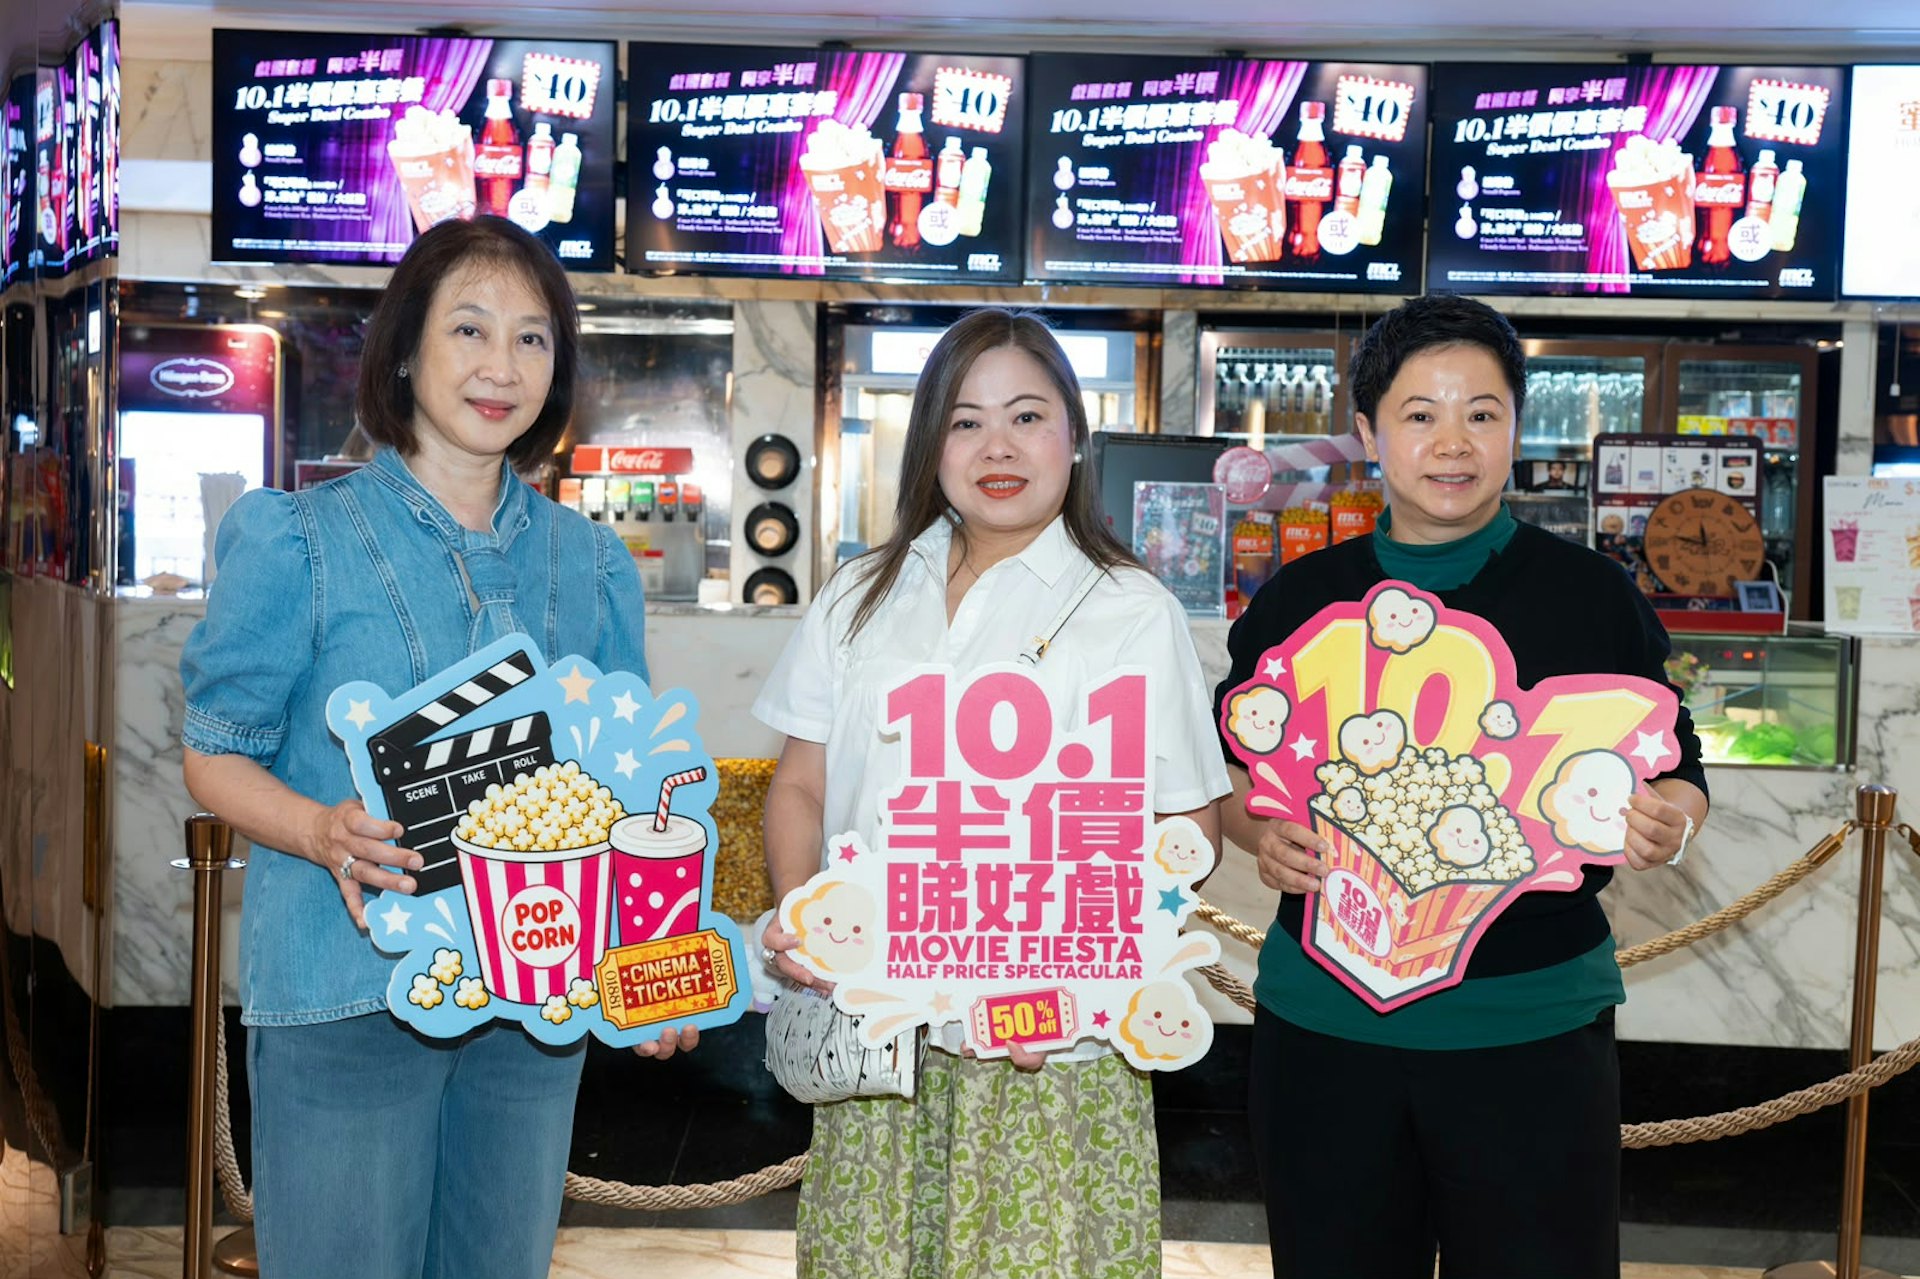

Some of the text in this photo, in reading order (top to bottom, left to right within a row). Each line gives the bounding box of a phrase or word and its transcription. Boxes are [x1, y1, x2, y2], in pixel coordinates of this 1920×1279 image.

[887, 672, 1146, 780] 10.1
[461, 770, 487, 785] TAKE
[513, 755, 538, 770] ROLL
[405, 784, 439, 803] SCENE
[887, 780, 1146, 862] 半價
[887, 862, 1144, 933] 睇好戲
[515, 899, 563, 927] POP
[512, 924, 574, 951] CORN
[887, 935, 1143, 963] MOVIE FIESTA
[630, 954, 700, 984] CINEMA
[711, 949, 728, 987] 01881
[887, 964, 1142, 979] HALF PRICE SPECTACULAR
[604, 970, 622, 1009] 01881
[632, 973, 702, 1005] TICKET
[991, 999, 1057, 1039] 50% off
